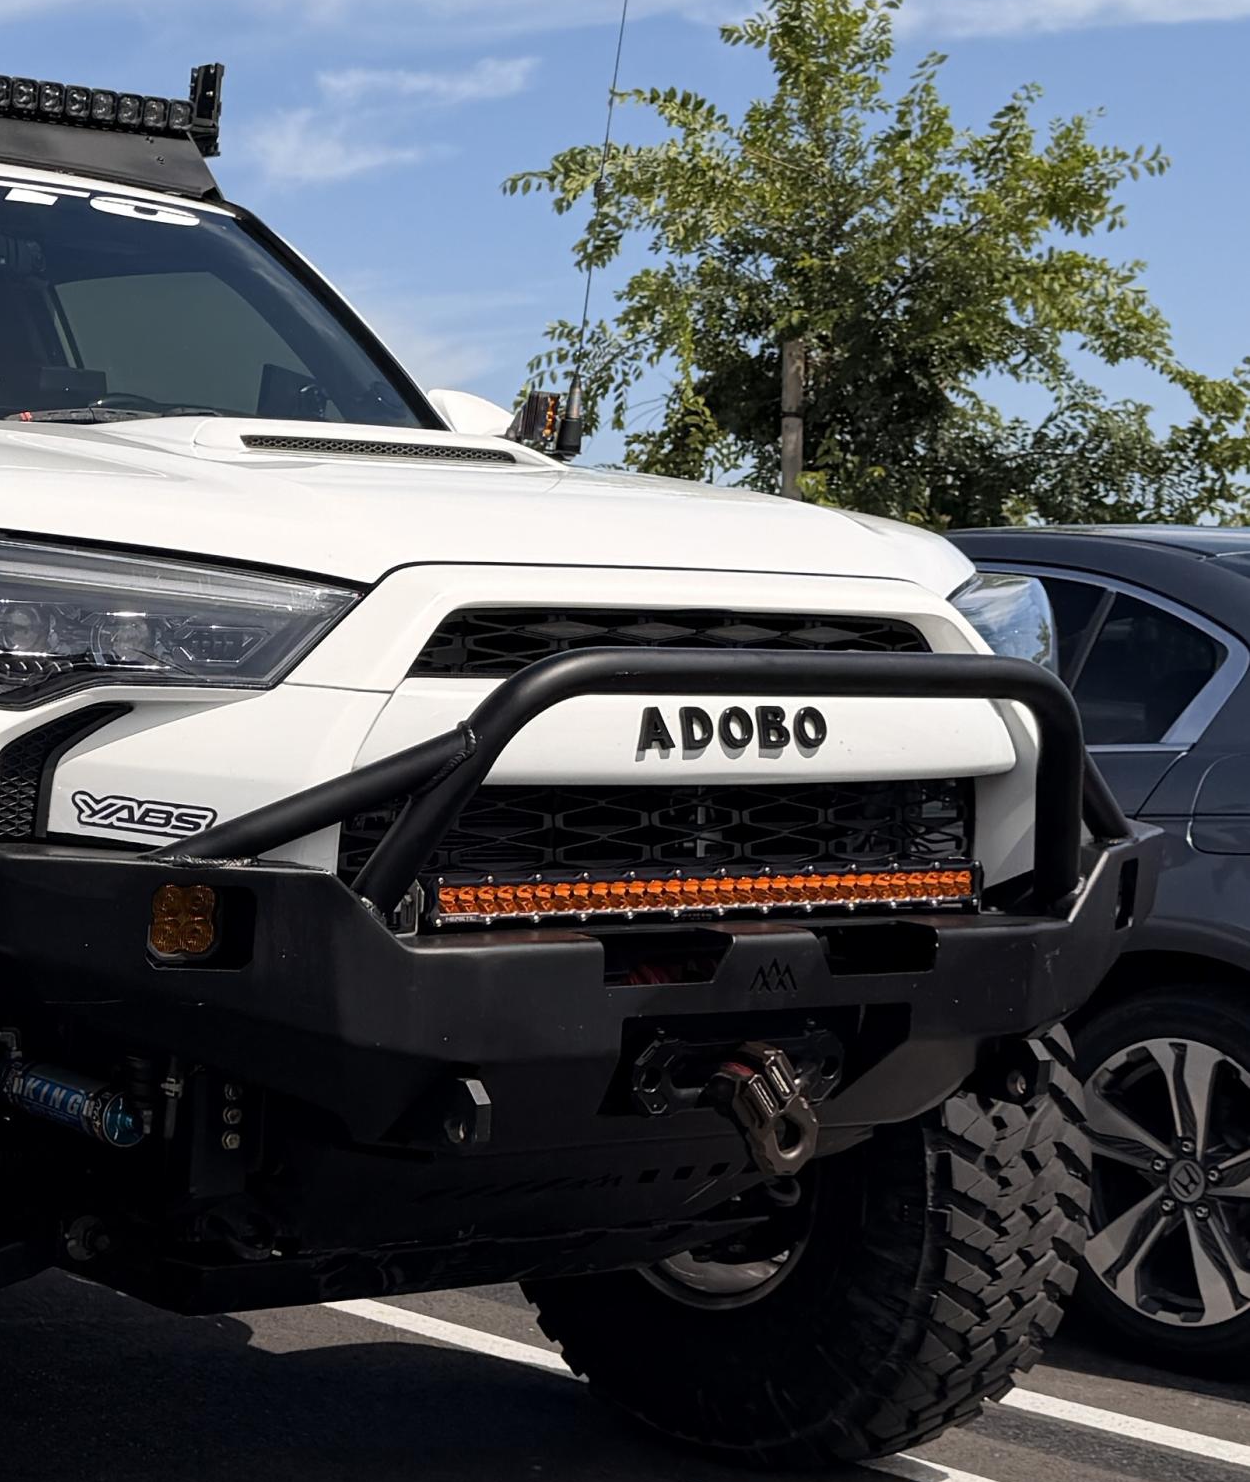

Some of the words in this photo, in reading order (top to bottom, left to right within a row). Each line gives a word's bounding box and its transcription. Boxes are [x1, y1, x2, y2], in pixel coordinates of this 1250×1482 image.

[636, 705, 828, 752] ADOBO
[76, 795, 212, 834] YABS
[23, 1076, 84, 1116] KING
